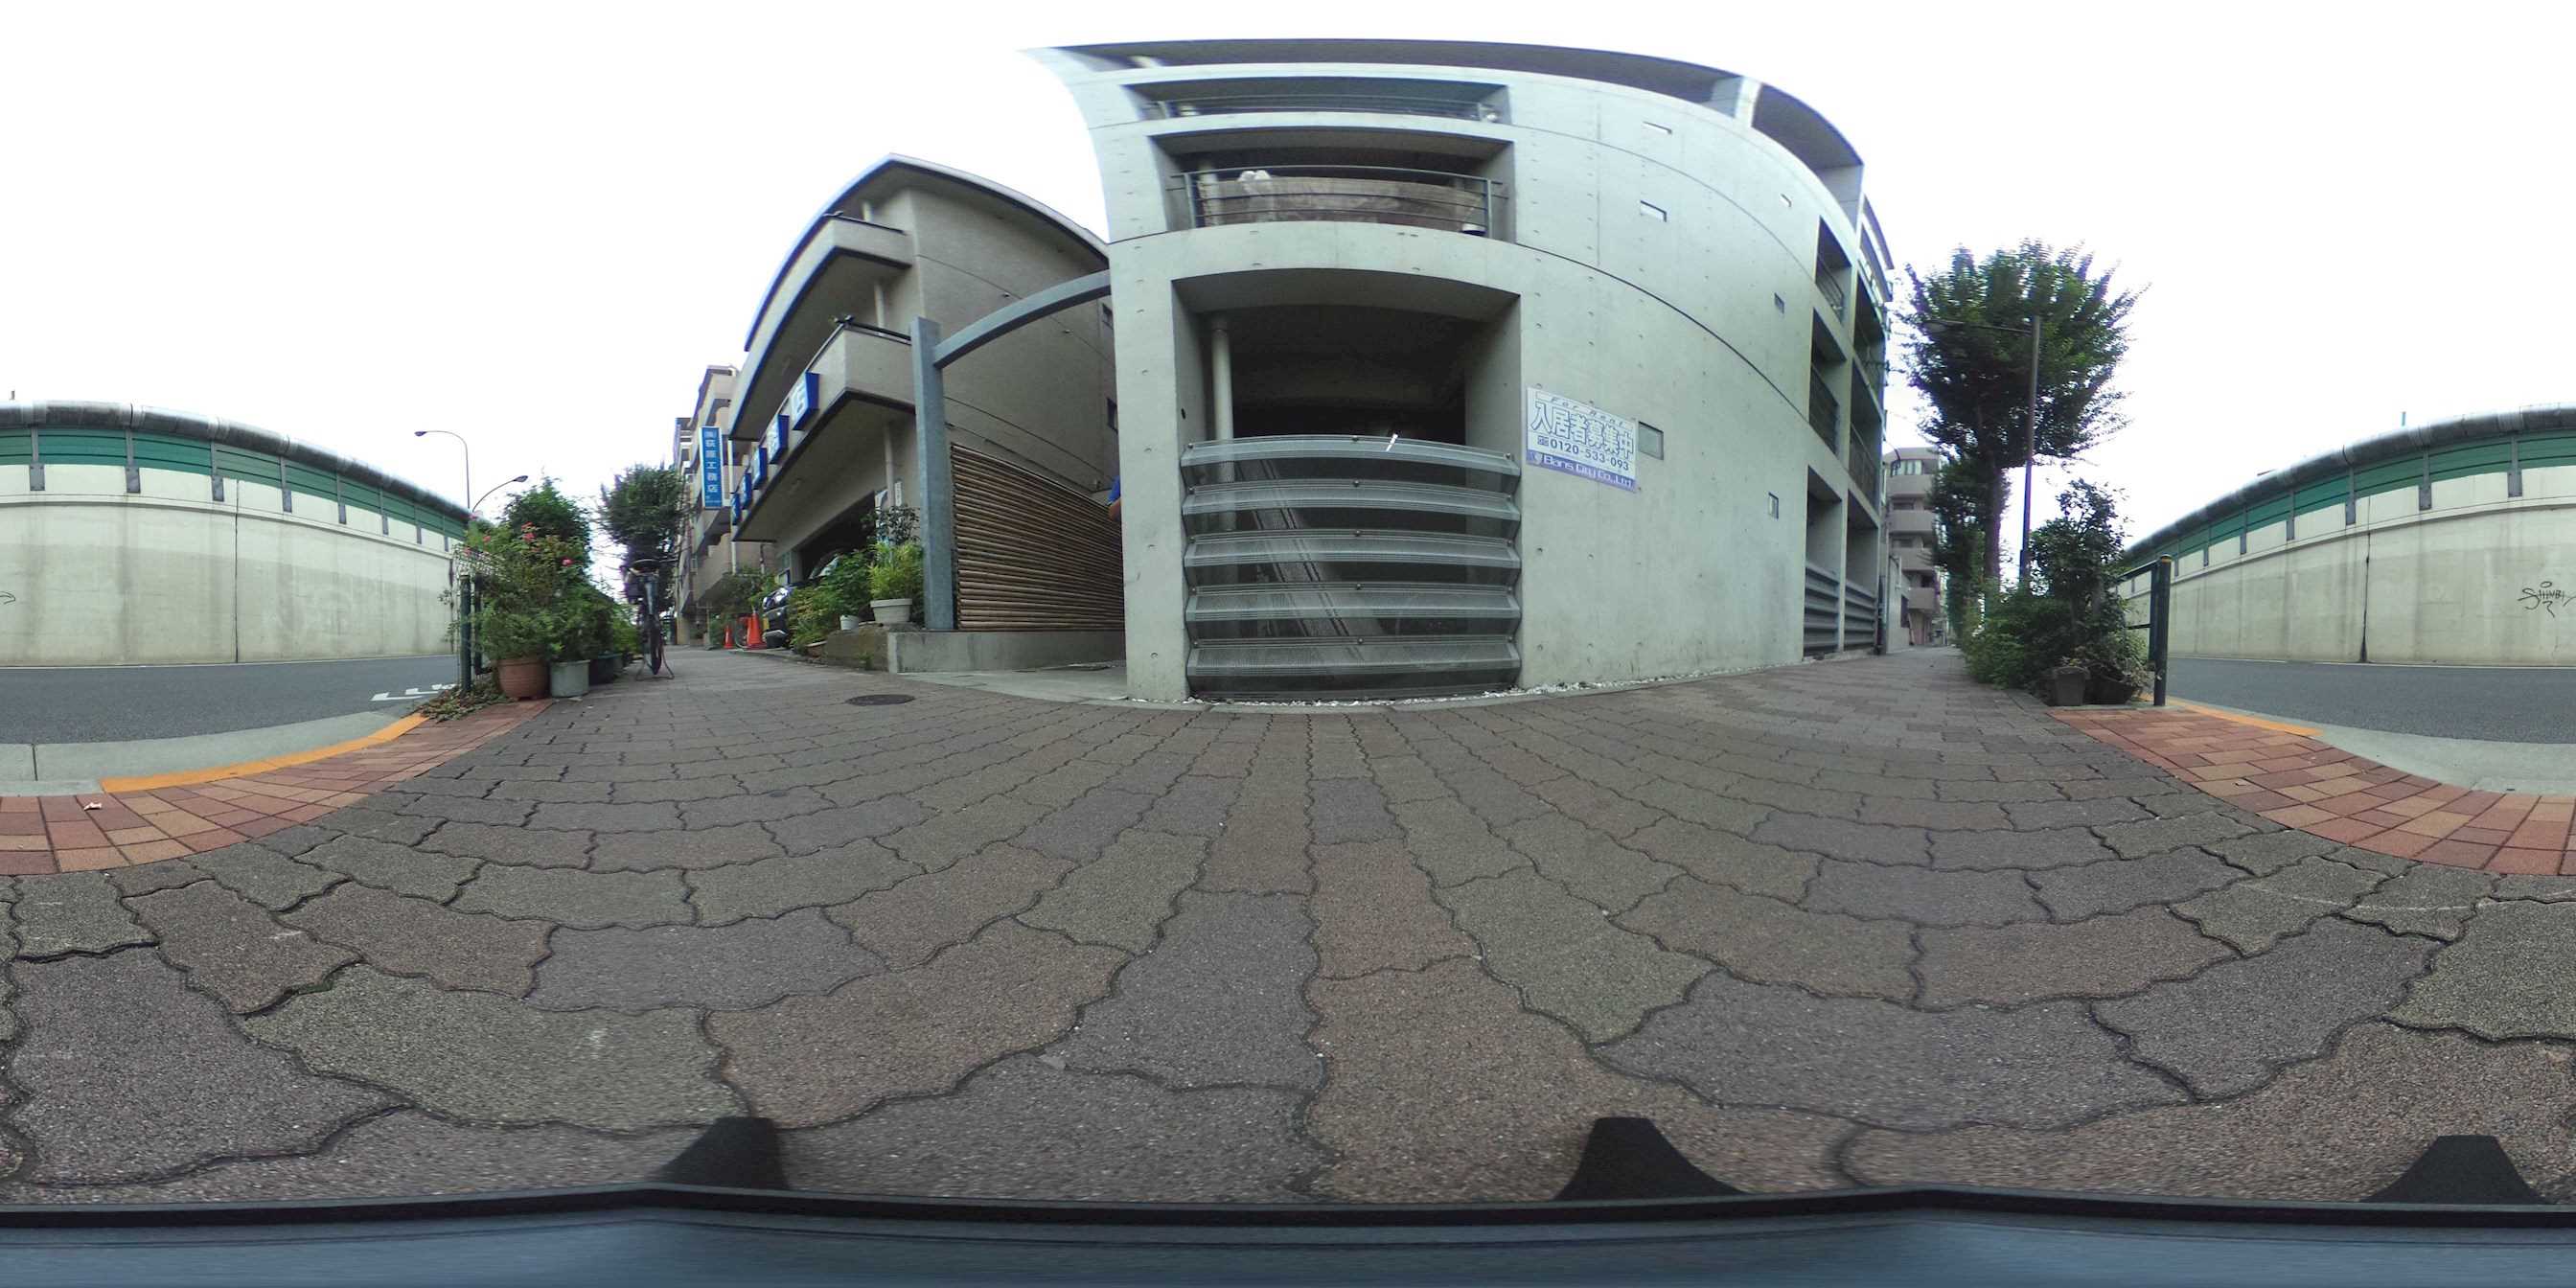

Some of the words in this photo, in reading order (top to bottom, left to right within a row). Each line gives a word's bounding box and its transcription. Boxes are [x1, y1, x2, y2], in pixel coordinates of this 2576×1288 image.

[1552, 396, 1577, 410] For
[1531, 402, 1634, 460] 入居者募集中
[1550, 438, 1629, 471] 0120-533-093
